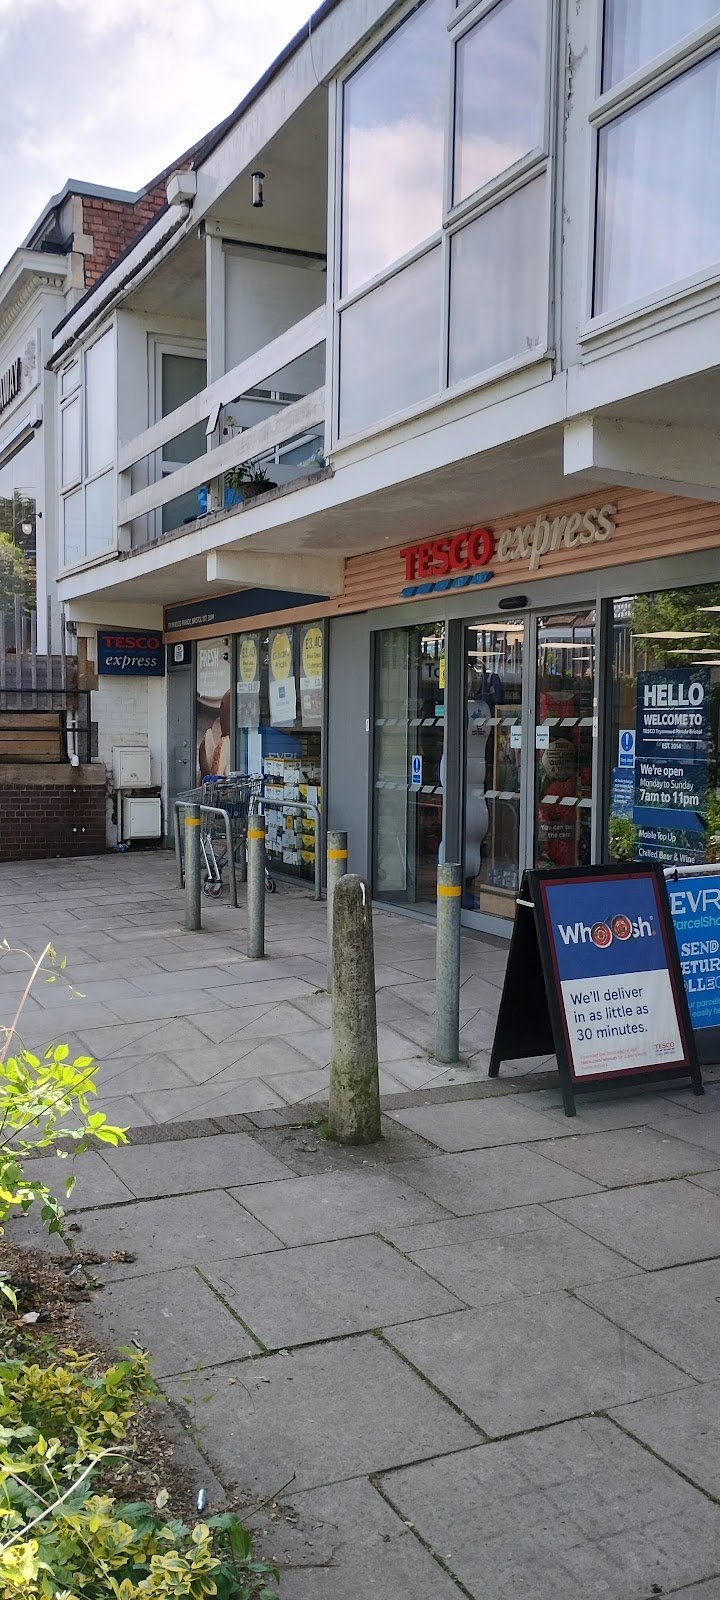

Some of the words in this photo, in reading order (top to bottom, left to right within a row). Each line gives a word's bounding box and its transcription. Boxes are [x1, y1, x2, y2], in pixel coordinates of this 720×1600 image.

[400, 528, 495, 580] TESCO
[496, 504, 617, 571] express
[102, 636, 160, 649] TESCO
[105, 655, 157, 669] express
[643, 683, 705, 706] HELLO
[643, 714, 688, 726] WELCOME
[689, 713, 703, 726] TO
[640, 764, 663, 775] We're
[663, 768, 684, 778] open
[640, 778, 662, 790] Monday
[661, 780, 670, 788] to
[670, 780, 694, 791] Sunday
[640, 789, 660, 802] 7am
[660, 791, 671, 803] to
[672, 791, 699, 807] 11pm
[638, 829, 657, 839] Mobile
[656, 831, 667, 841] Top
[667, 832, 677, 842] Up
[638, 848, 658, 859] Chilled
[658, 851, 673, 860] Beer
[673, 853, 679, 862] &
[680, 854, 696, 864] Wine
[681, 940, 720, 957] SEND
[680, 957, 720, 975] ETUR
[604, 987, 643, 1001] deliver
[573, 1011, 586, 1023] in
[589, 1011, 603, 1021] as
[605, 1005, 633, 1019] little
[636, 1005, 649, 1015] as
[576, 1028, 593, 1041] 30
[596, 1023, 648, 1039] minutes.
[655, 1041, 675, 1050] TESCO
